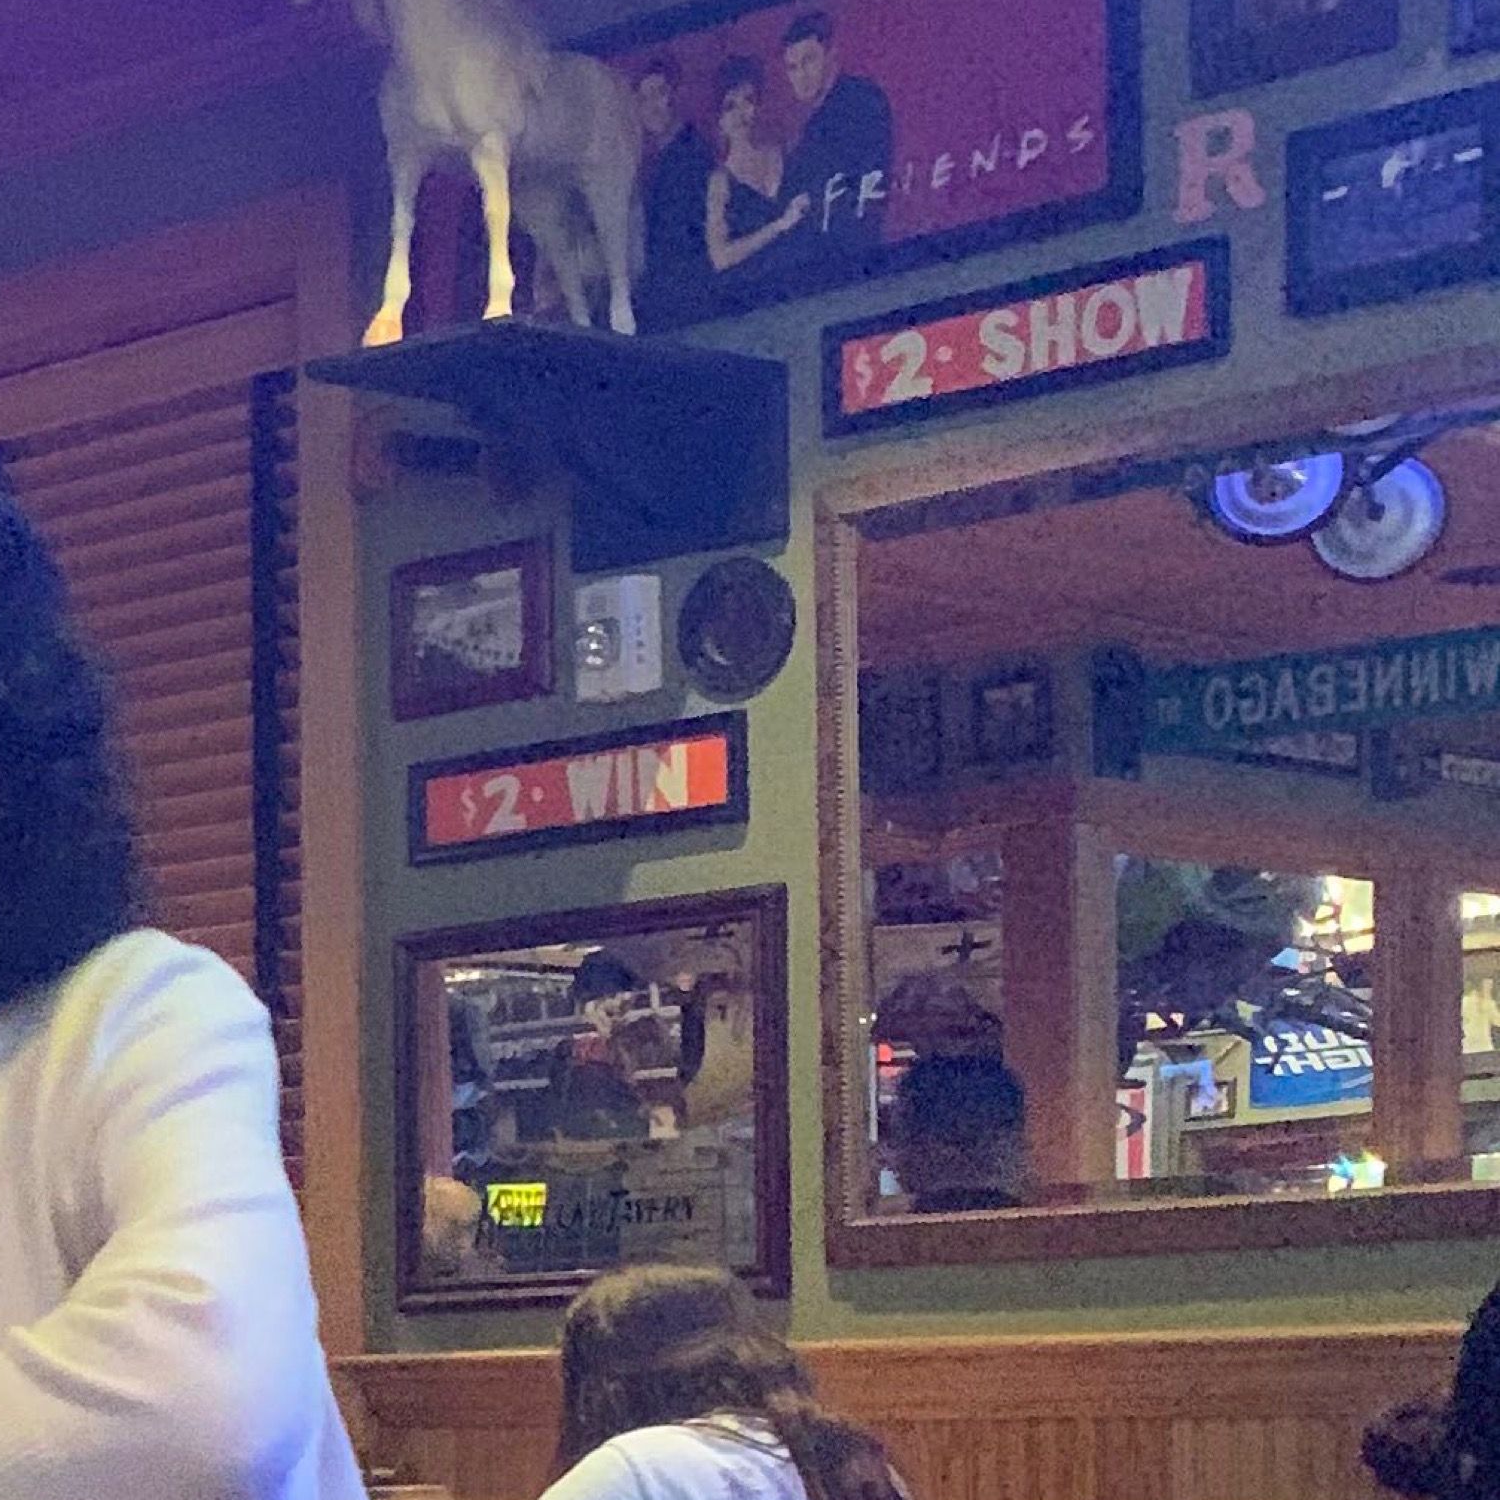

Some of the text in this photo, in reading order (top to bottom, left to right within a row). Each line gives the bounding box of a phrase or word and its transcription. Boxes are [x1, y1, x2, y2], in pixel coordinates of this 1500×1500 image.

[1173, 108, 1267, 224] R
[979, 266, 1193, 381] SHOW
[566, 742, 689, 823] WIN
